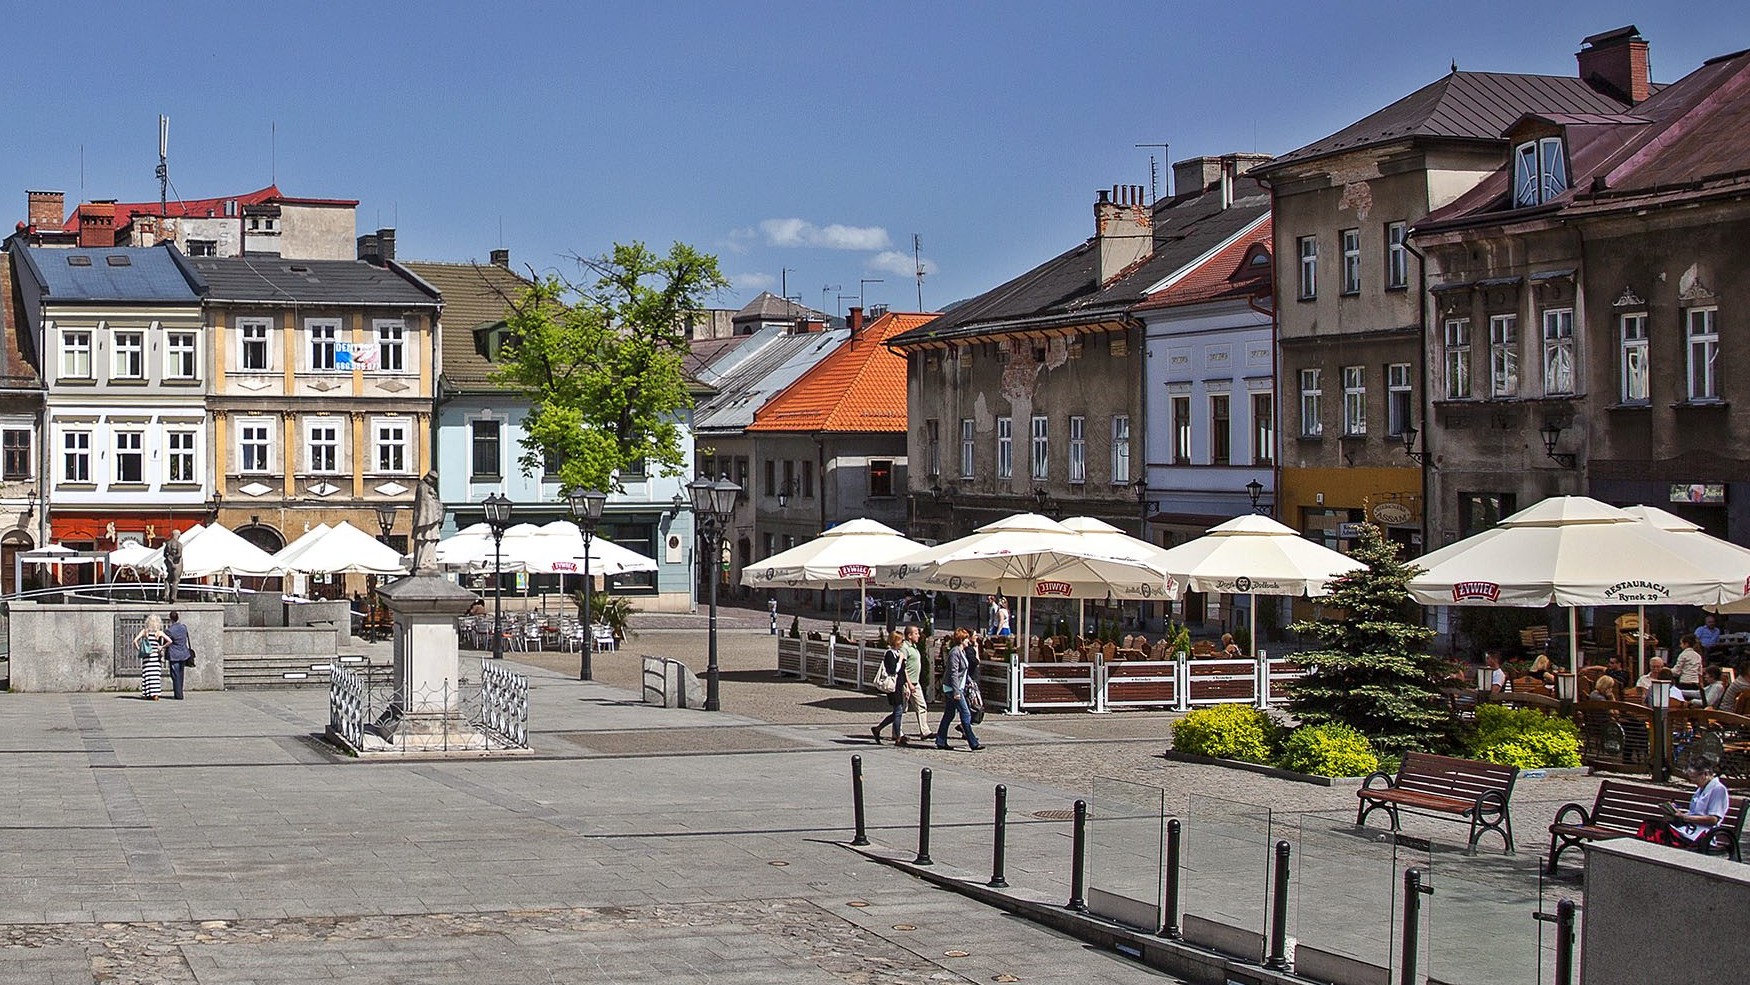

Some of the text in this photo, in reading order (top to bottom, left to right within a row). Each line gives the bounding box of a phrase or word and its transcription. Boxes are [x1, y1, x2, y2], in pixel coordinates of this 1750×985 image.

[1375, 511, 1408, 523] ASSAM
[1604, 580, 1670, 597] RESTAURACJA
[1618, 593, 1658, 602] Rynek 29
